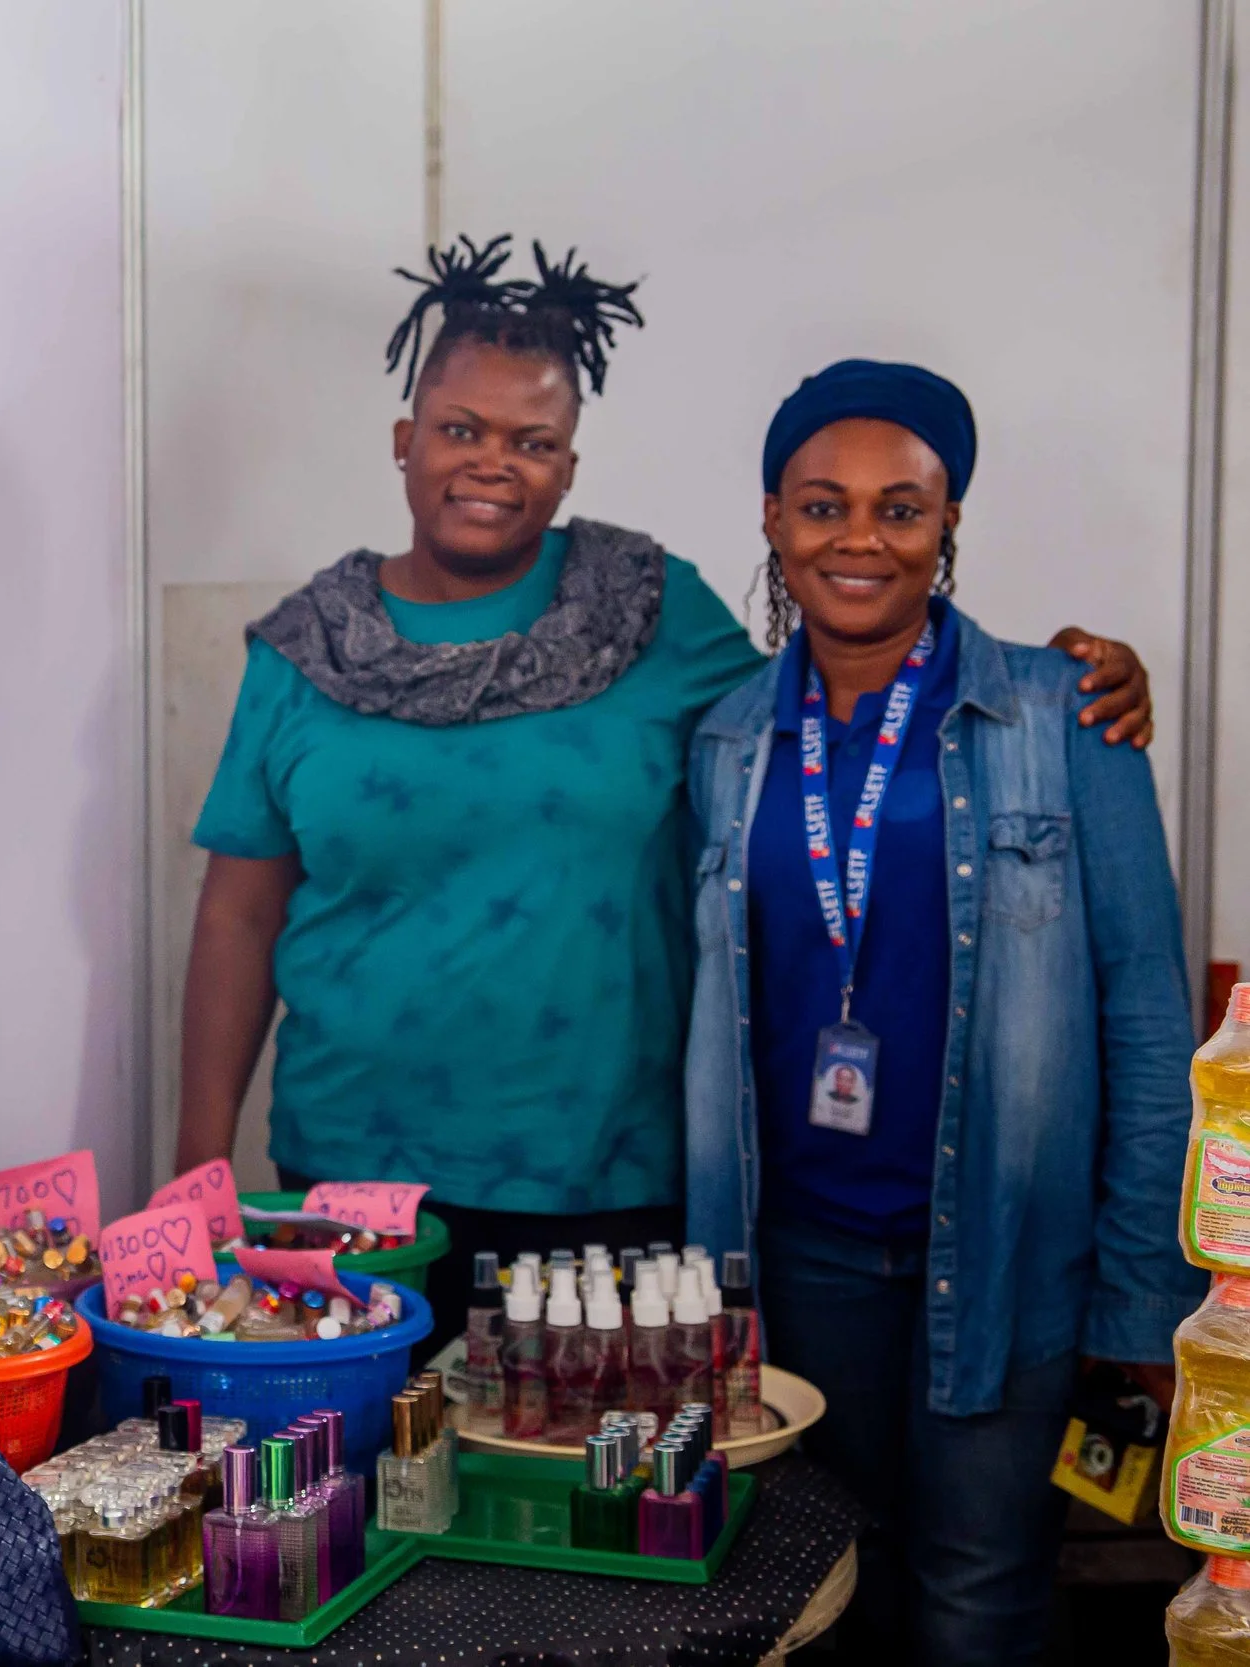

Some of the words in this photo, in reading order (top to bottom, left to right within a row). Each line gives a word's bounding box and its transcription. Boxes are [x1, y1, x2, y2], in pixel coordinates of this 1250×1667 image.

[857, 763, 887, 815] LSETF
[804, 794, 828, 845] LSETF
[847, 849, 867, 903] LSETF
[816, 879, 841, 934] LSETF
